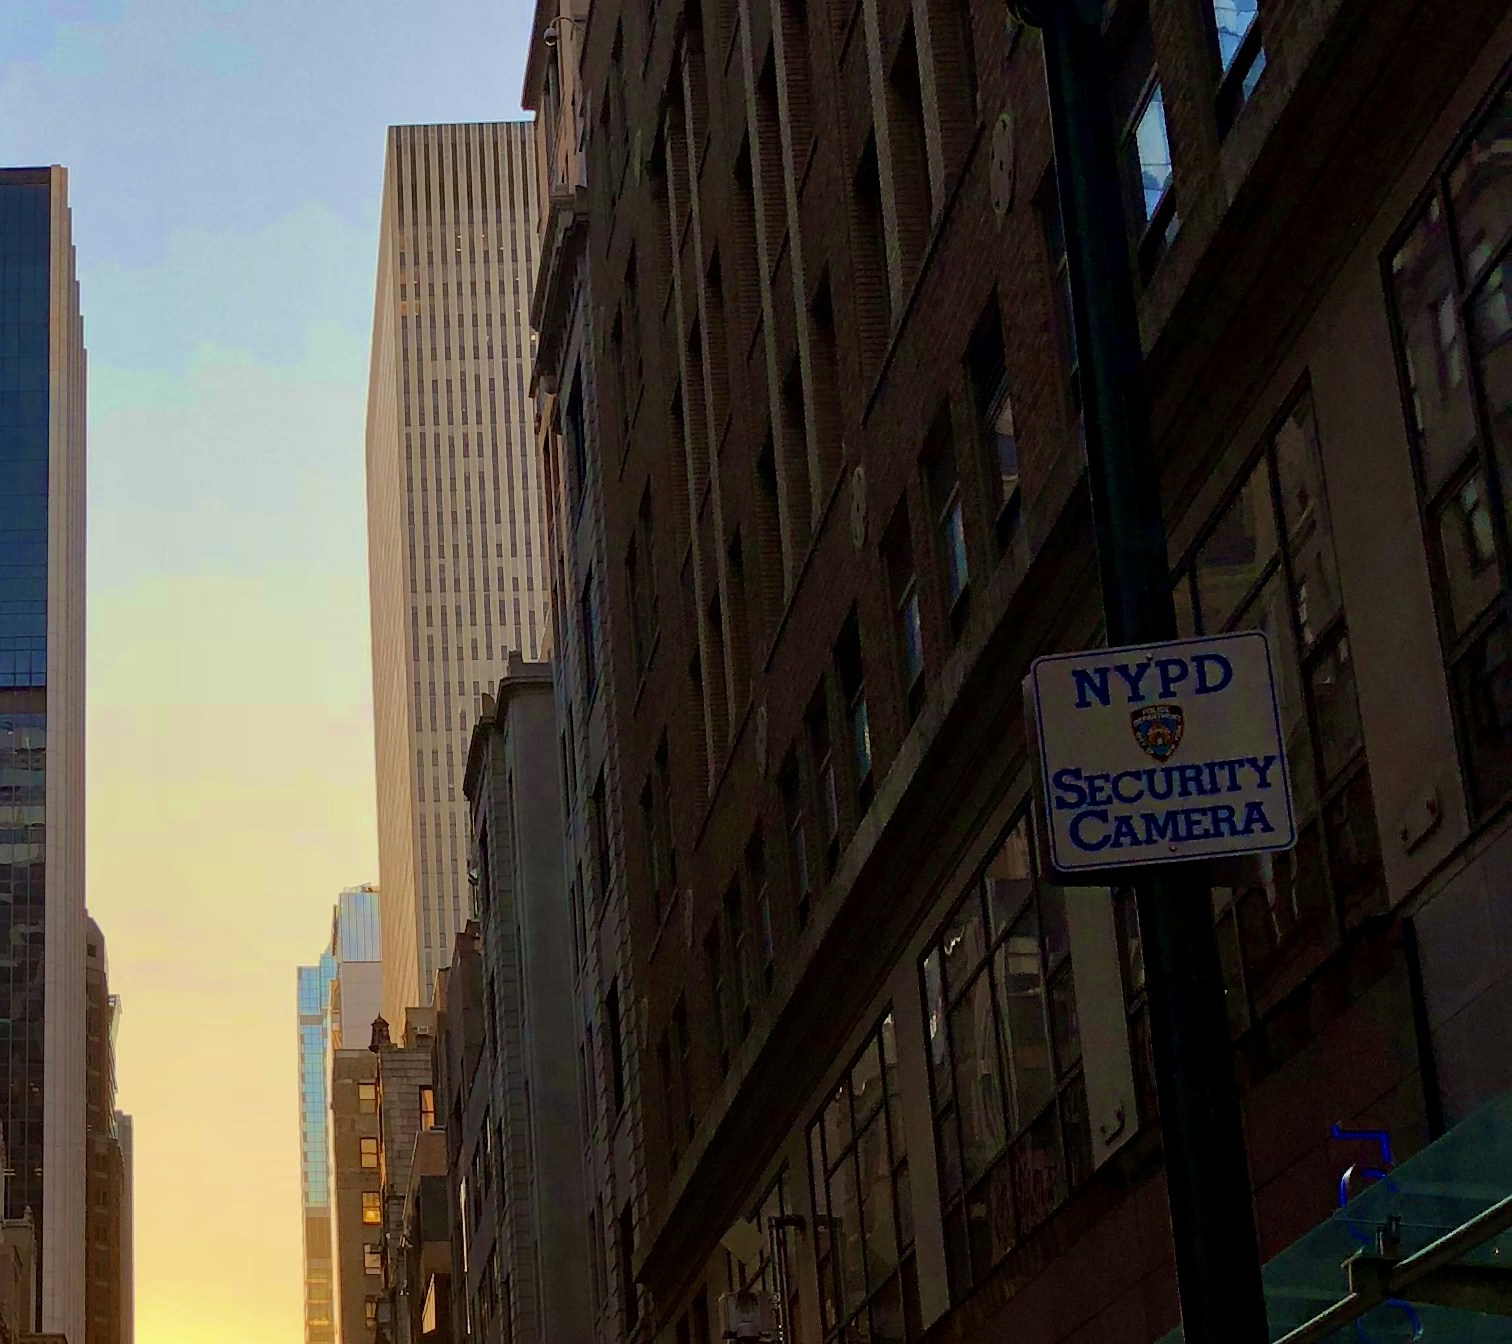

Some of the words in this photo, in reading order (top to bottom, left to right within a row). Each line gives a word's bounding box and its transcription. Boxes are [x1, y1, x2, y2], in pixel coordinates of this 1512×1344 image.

[1072, 654, 1233, 708] NYPD
[1053, 755, 1276, 810] SECURITY
[1069, 801, 1275, 851] CAMERA
